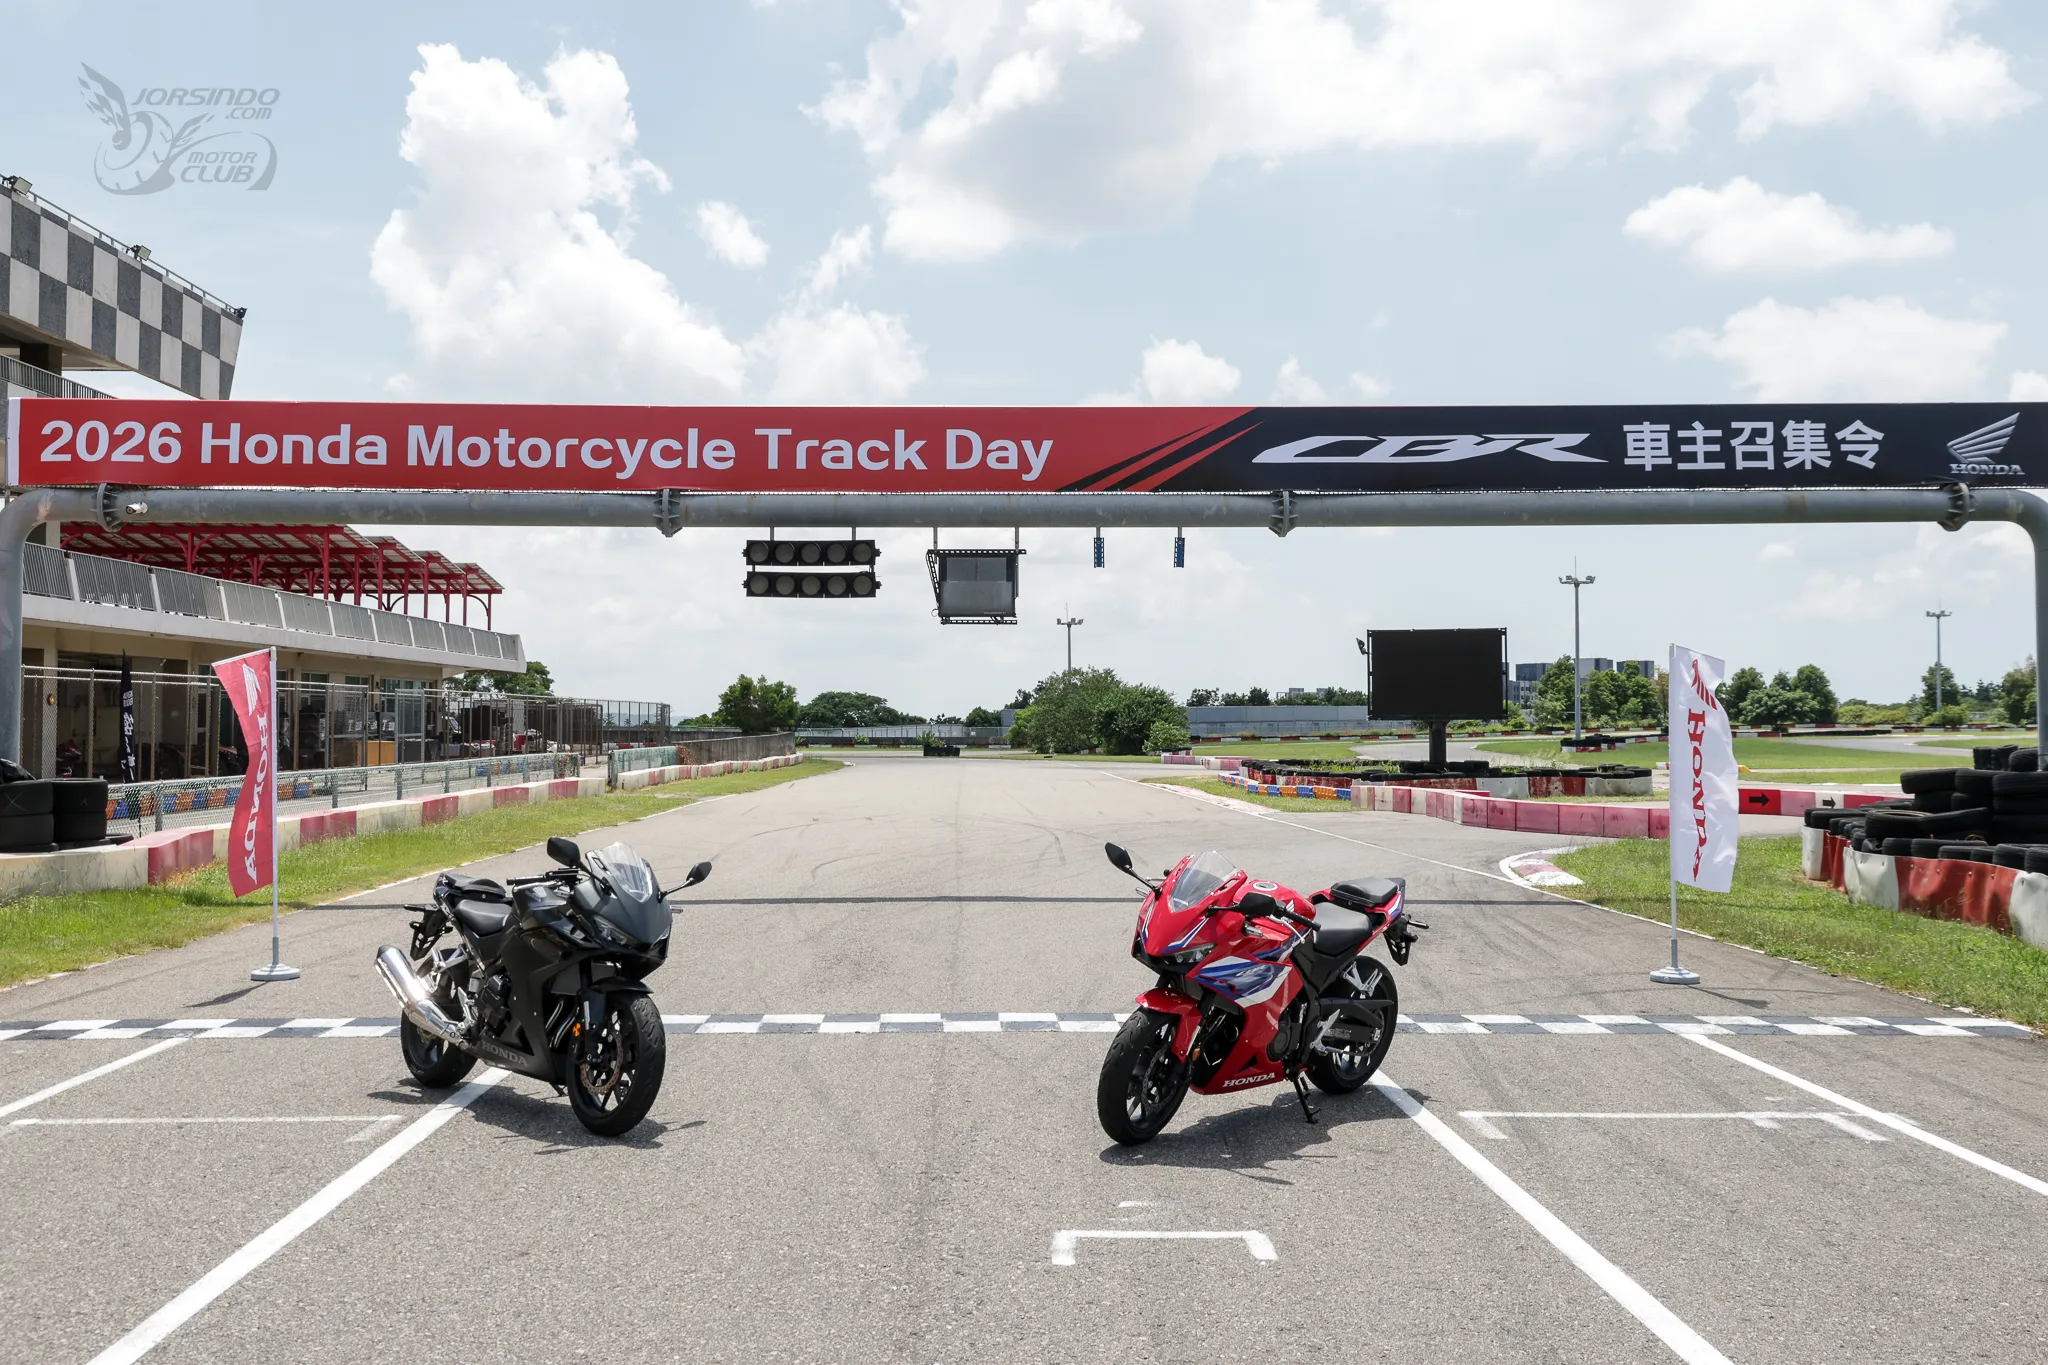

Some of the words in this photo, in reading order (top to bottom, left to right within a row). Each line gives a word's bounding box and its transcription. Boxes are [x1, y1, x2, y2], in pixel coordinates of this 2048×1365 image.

[40, 420, 182, 464] 2026
[201, 422, 388, 466] Honda
[407, 425, 736, 480] Motorcycle
[754, 428, 929, 471] Track
[946, 429, 1054, 482] Day
[1252, 433, 1609, 464] CBR
[1622, 419, 1885, 472] 車主召集令
[1949, 463, 2026, 475] HONDA
[481, 1040, 528, 1067] HONDA
[1222, 1072, 1276, 1088] HONDA
